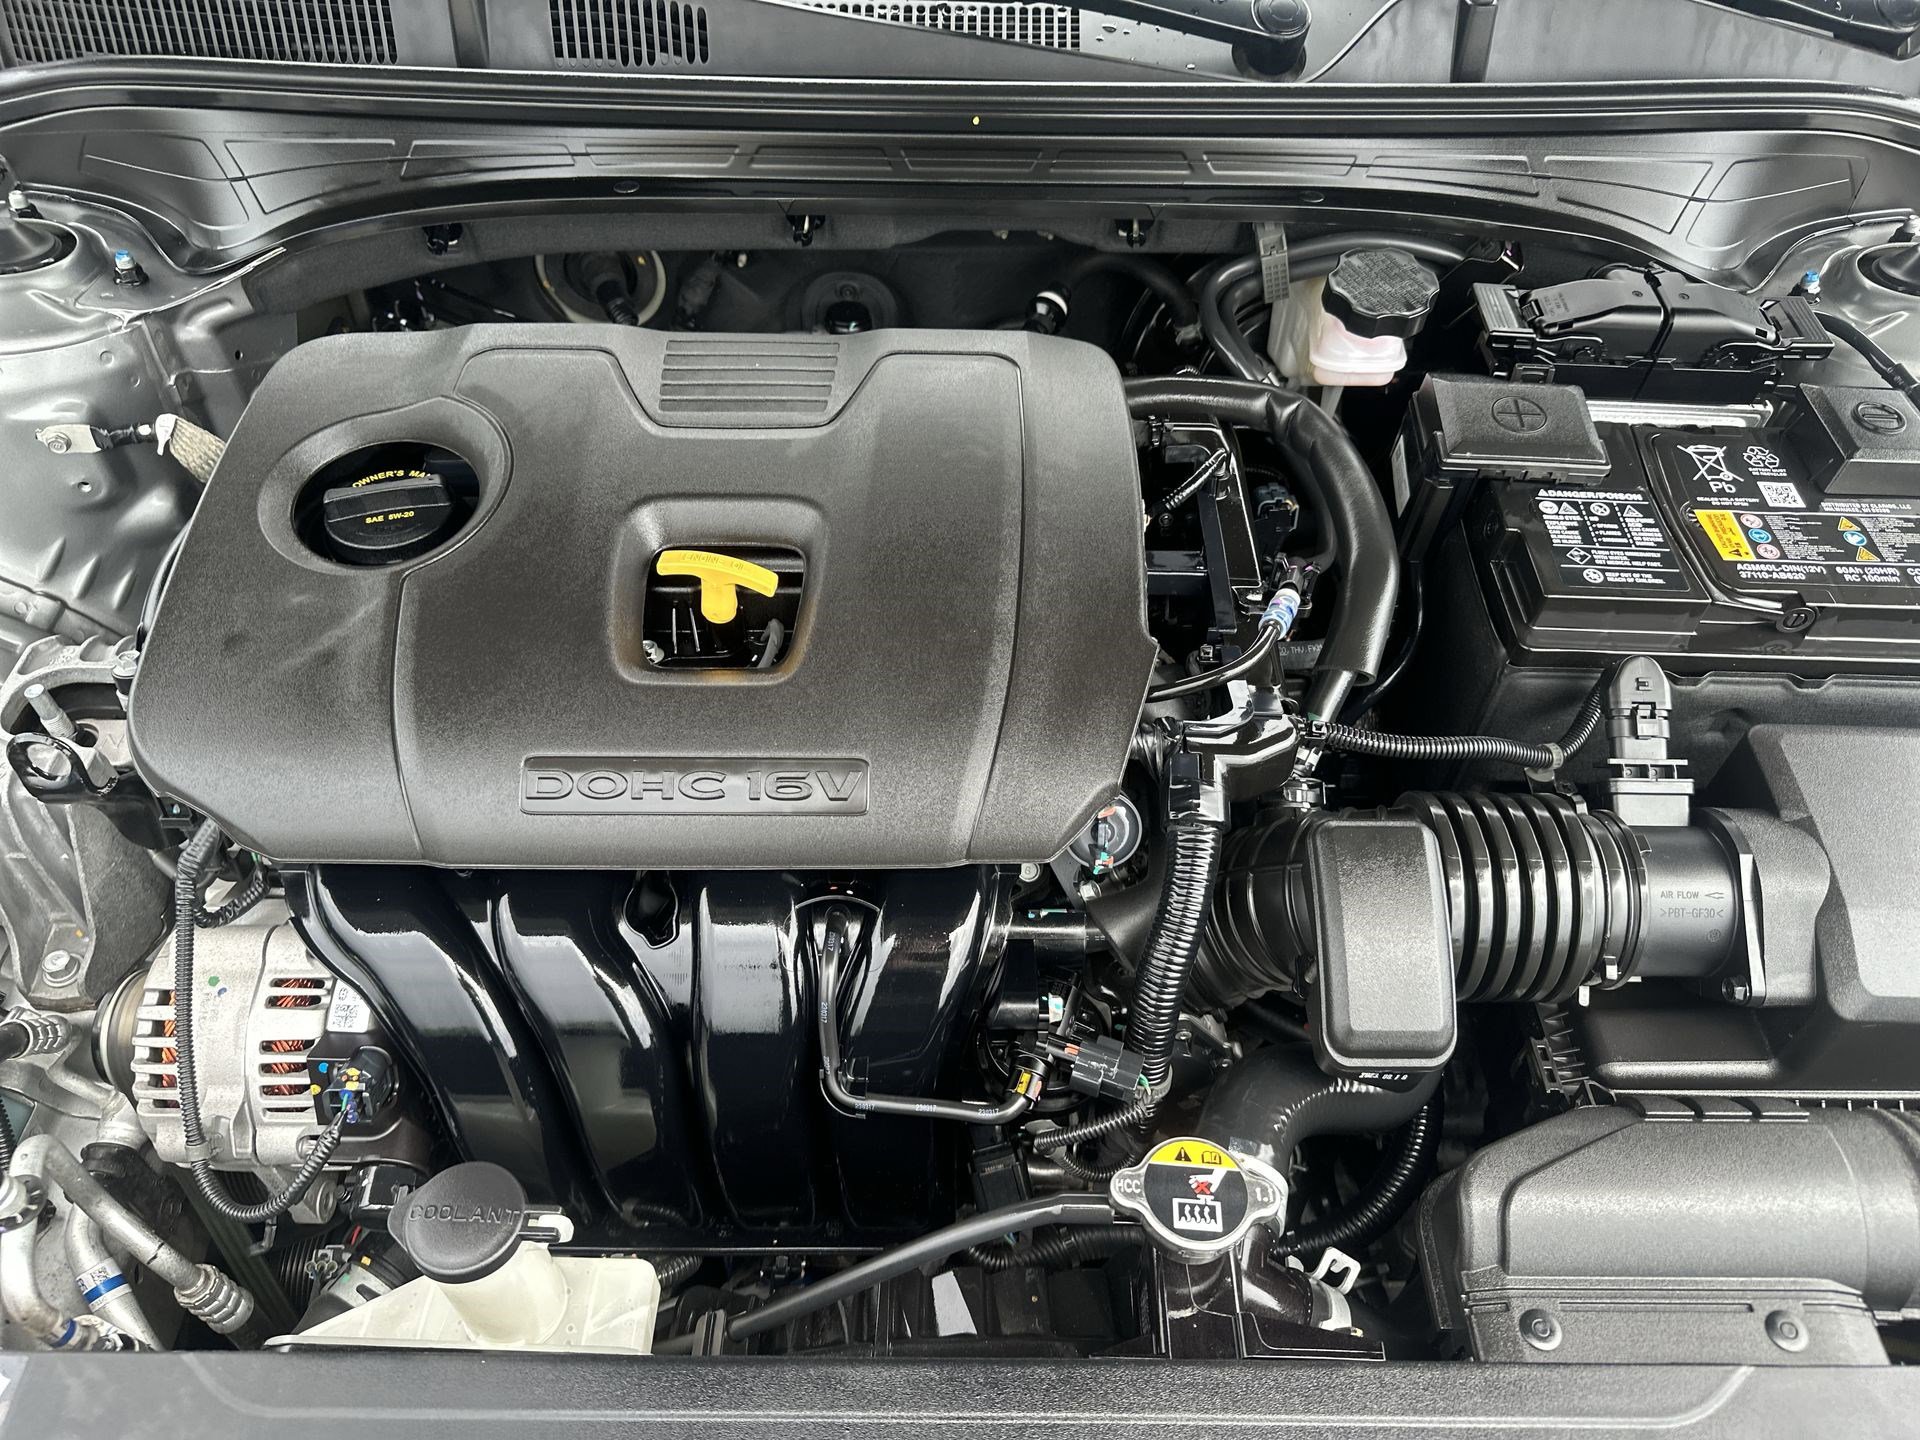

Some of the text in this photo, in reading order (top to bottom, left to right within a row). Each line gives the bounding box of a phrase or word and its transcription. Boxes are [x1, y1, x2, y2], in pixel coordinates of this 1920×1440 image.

[352, 470, 432, 488] OWNER'S MA
[1708, 481, 1736, 493] Pb
[1547, 490, 1643, 500] DANGER/POISON
[365, 511, 415, 524] SAE 5W-20
[1736, 563, 1827, 574] AGM60L-DIN(12V)
[1835, 566, 1900, 576] 60Ah (20HR)
[1843, 574, 1900, 582] RC 100min
[525, 769, 864, 801] DOHC 16V
[1660, 891, 1699, 899] AIR FLOW
[1115, 1178, 1141, 1194] HCC
[1255, 1186, 1274, 1202] 1.1
[408, 1204, 522, 1225] COOLANT
